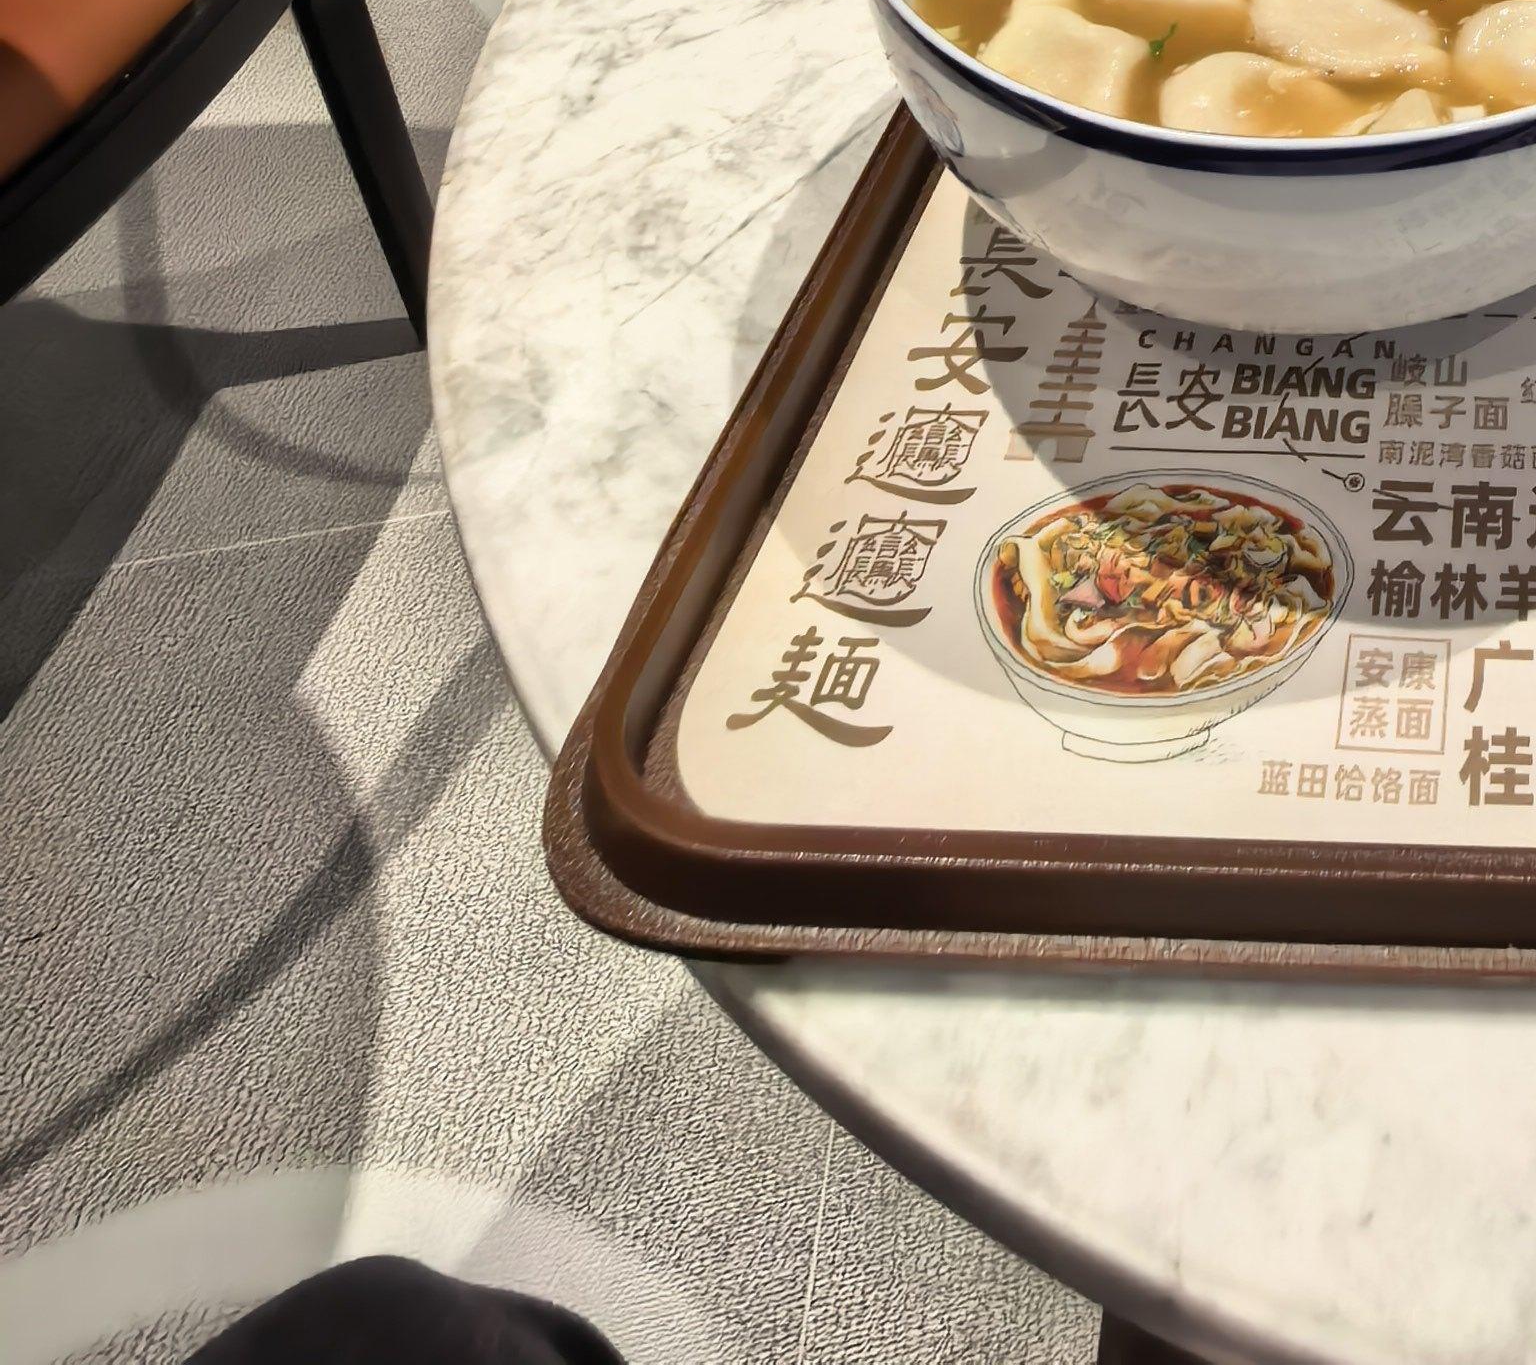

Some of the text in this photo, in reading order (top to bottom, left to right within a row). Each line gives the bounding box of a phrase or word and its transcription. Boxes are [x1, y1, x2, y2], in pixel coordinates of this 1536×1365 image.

[1138, 328, 1396, 359] CHANGAN
[1231, 363, 1377, 400] BIANG
[1391, 353, 1468, 388] 岐山
[1221, 405, 1372, 445] BIANG
[1354, 647, 1438, 691] 安康
[1349, 694, 1435, 740] 蒸面
[1257, 758, 1441, 806] 蓝田饸饹面
